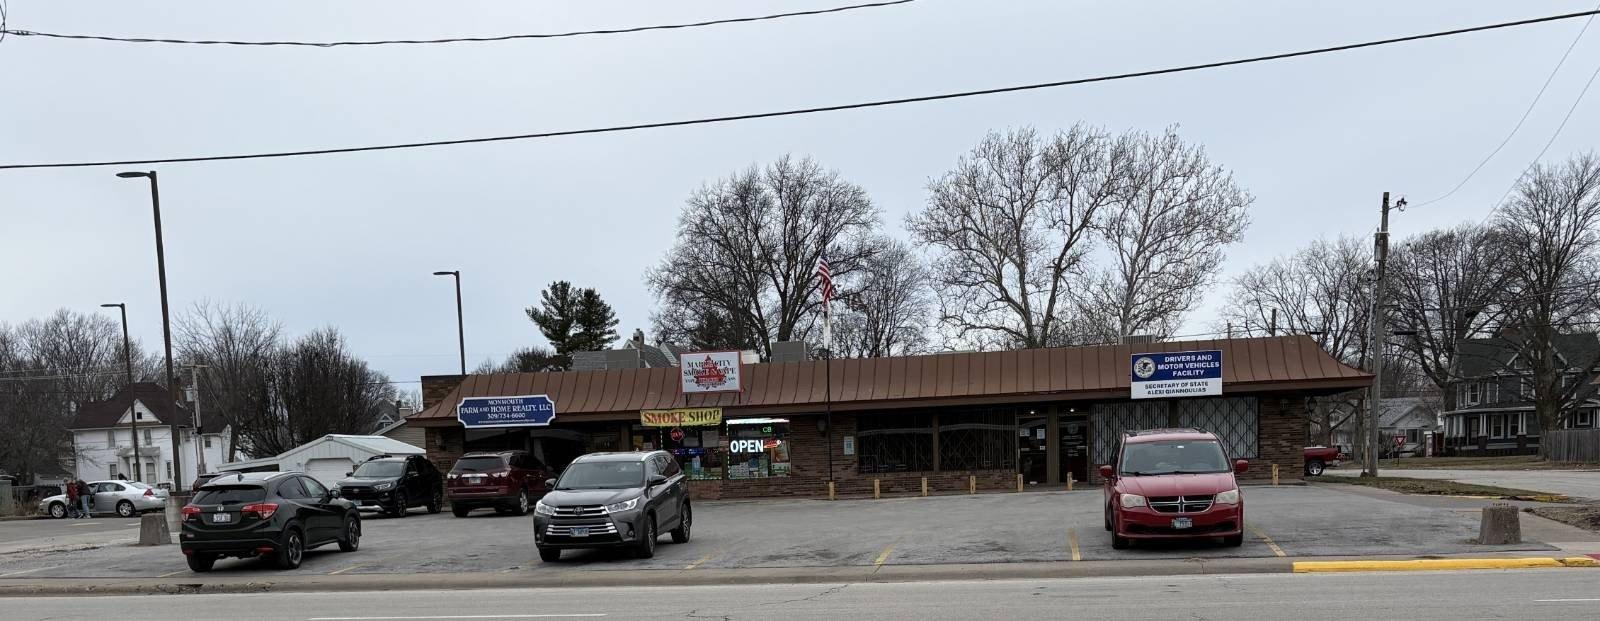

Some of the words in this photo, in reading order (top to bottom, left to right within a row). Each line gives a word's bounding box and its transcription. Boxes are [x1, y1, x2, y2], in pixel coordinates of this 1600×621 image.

[683, 368, 710, 377] SMOKE
[717, 367, 736, 375] VAPE
[643, 411, 686, 424] SMOKE
[688, 409, 720, 422] SHOP
[730, 439, 764, 453] OPEN
